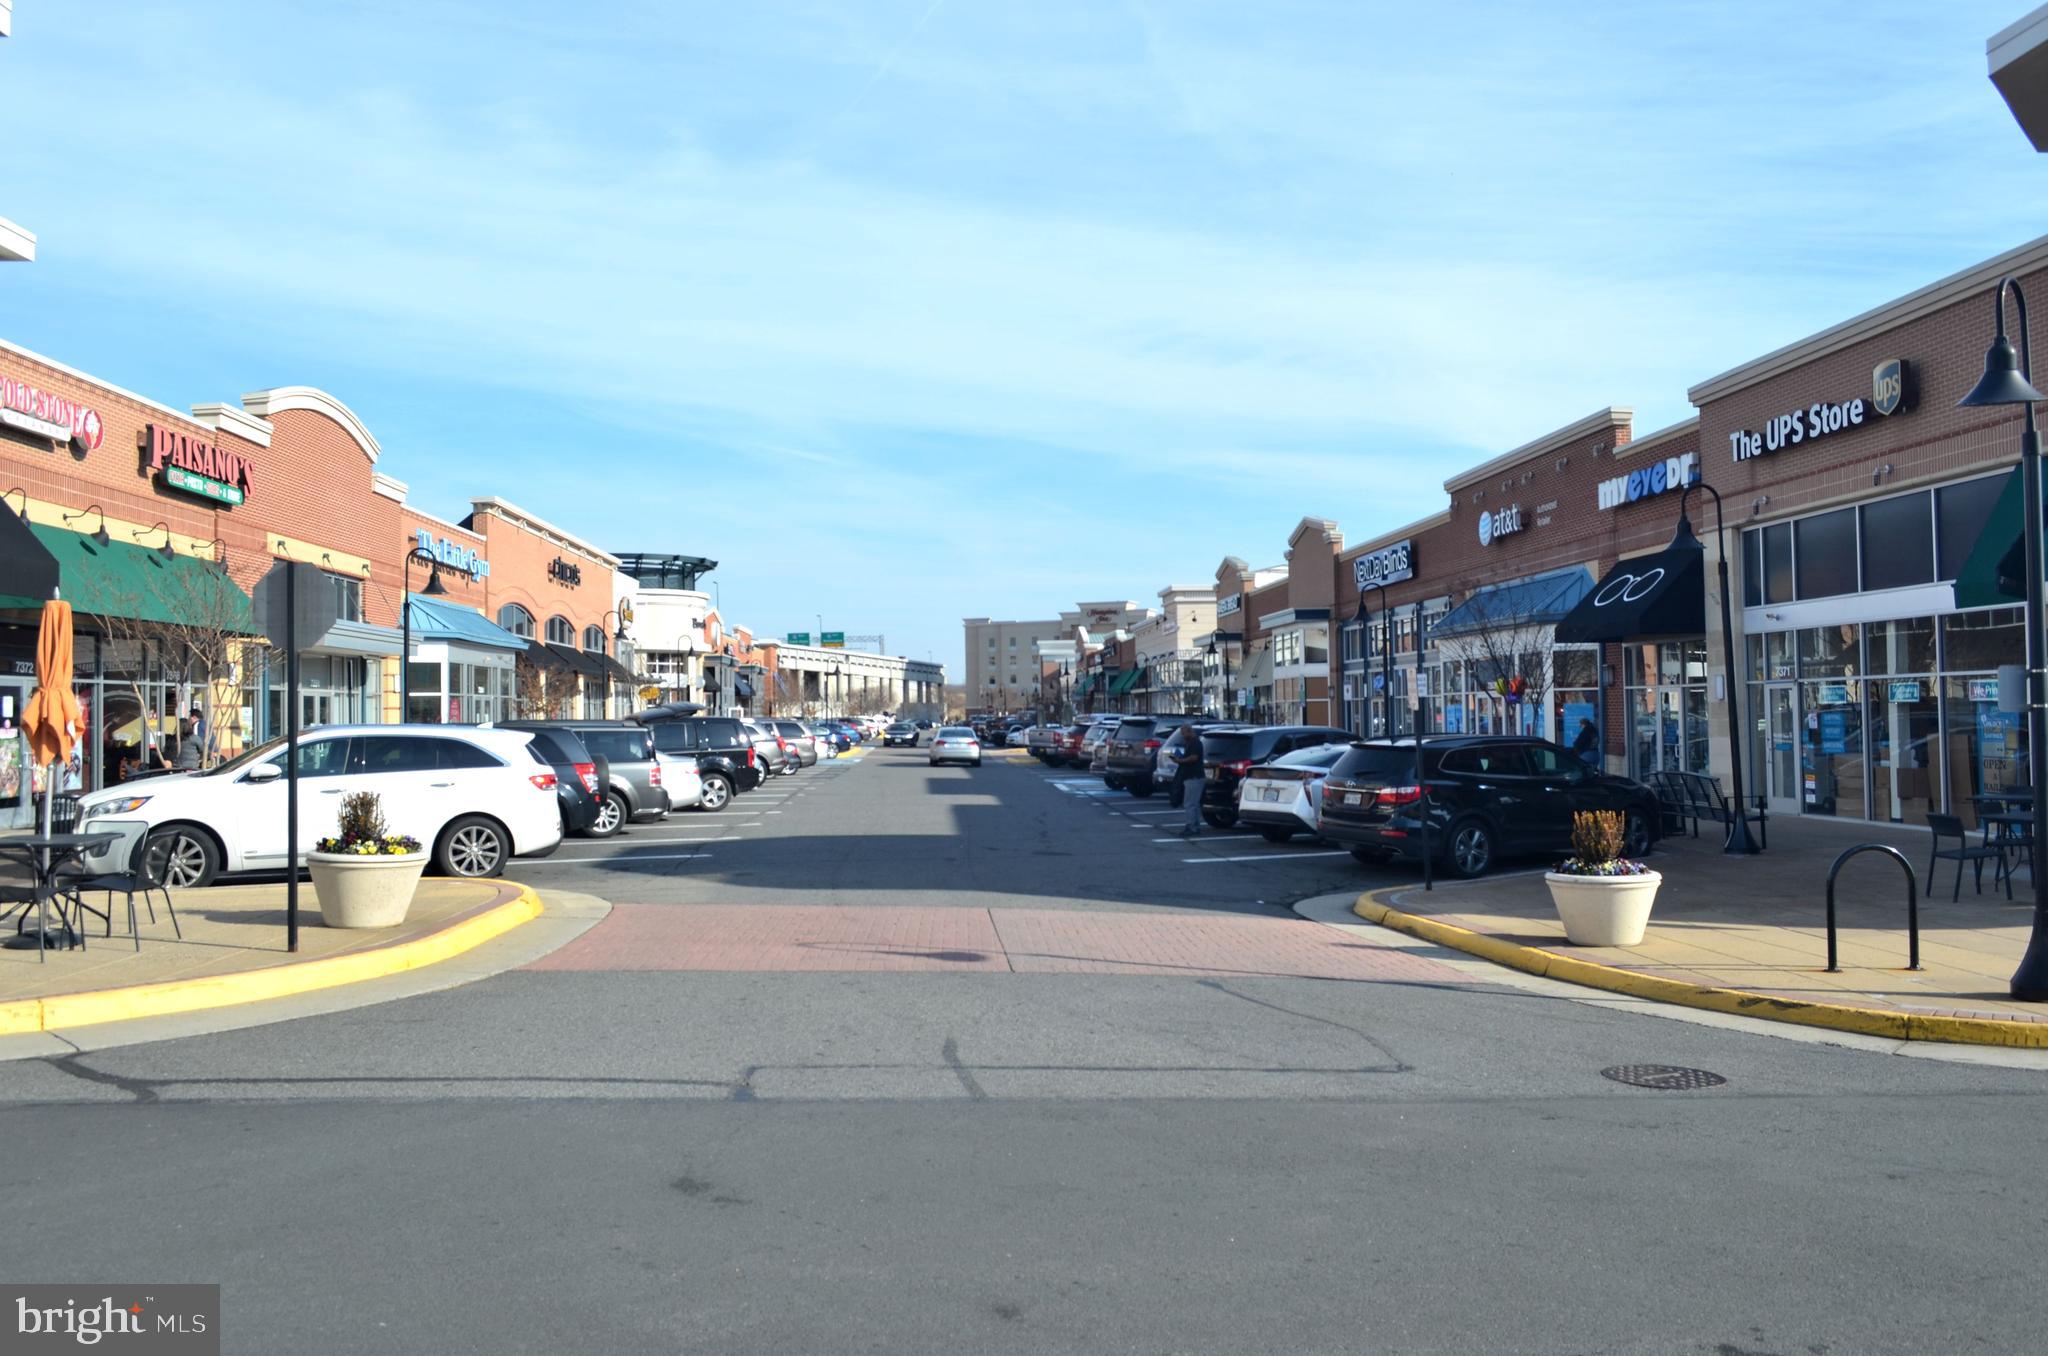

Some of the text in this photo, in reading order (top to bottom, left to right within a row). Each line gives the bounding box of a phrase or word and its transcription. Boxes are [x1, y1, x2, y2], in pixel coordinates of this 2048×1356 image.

[1875, 374, 1899, 407] ups
[36, 390, 82, 437] STONE
[1730, 398, 1864, 462] The UPS Store
[152, 424, 255, 498] PAISANO'S
[416, 528, 490, 582] The Little Gym
[1354, 551, 1407, 583] Next Day Blinds
[15, 661, 34, 674] 7372
[1985, 685, 1999, 696] Prin
